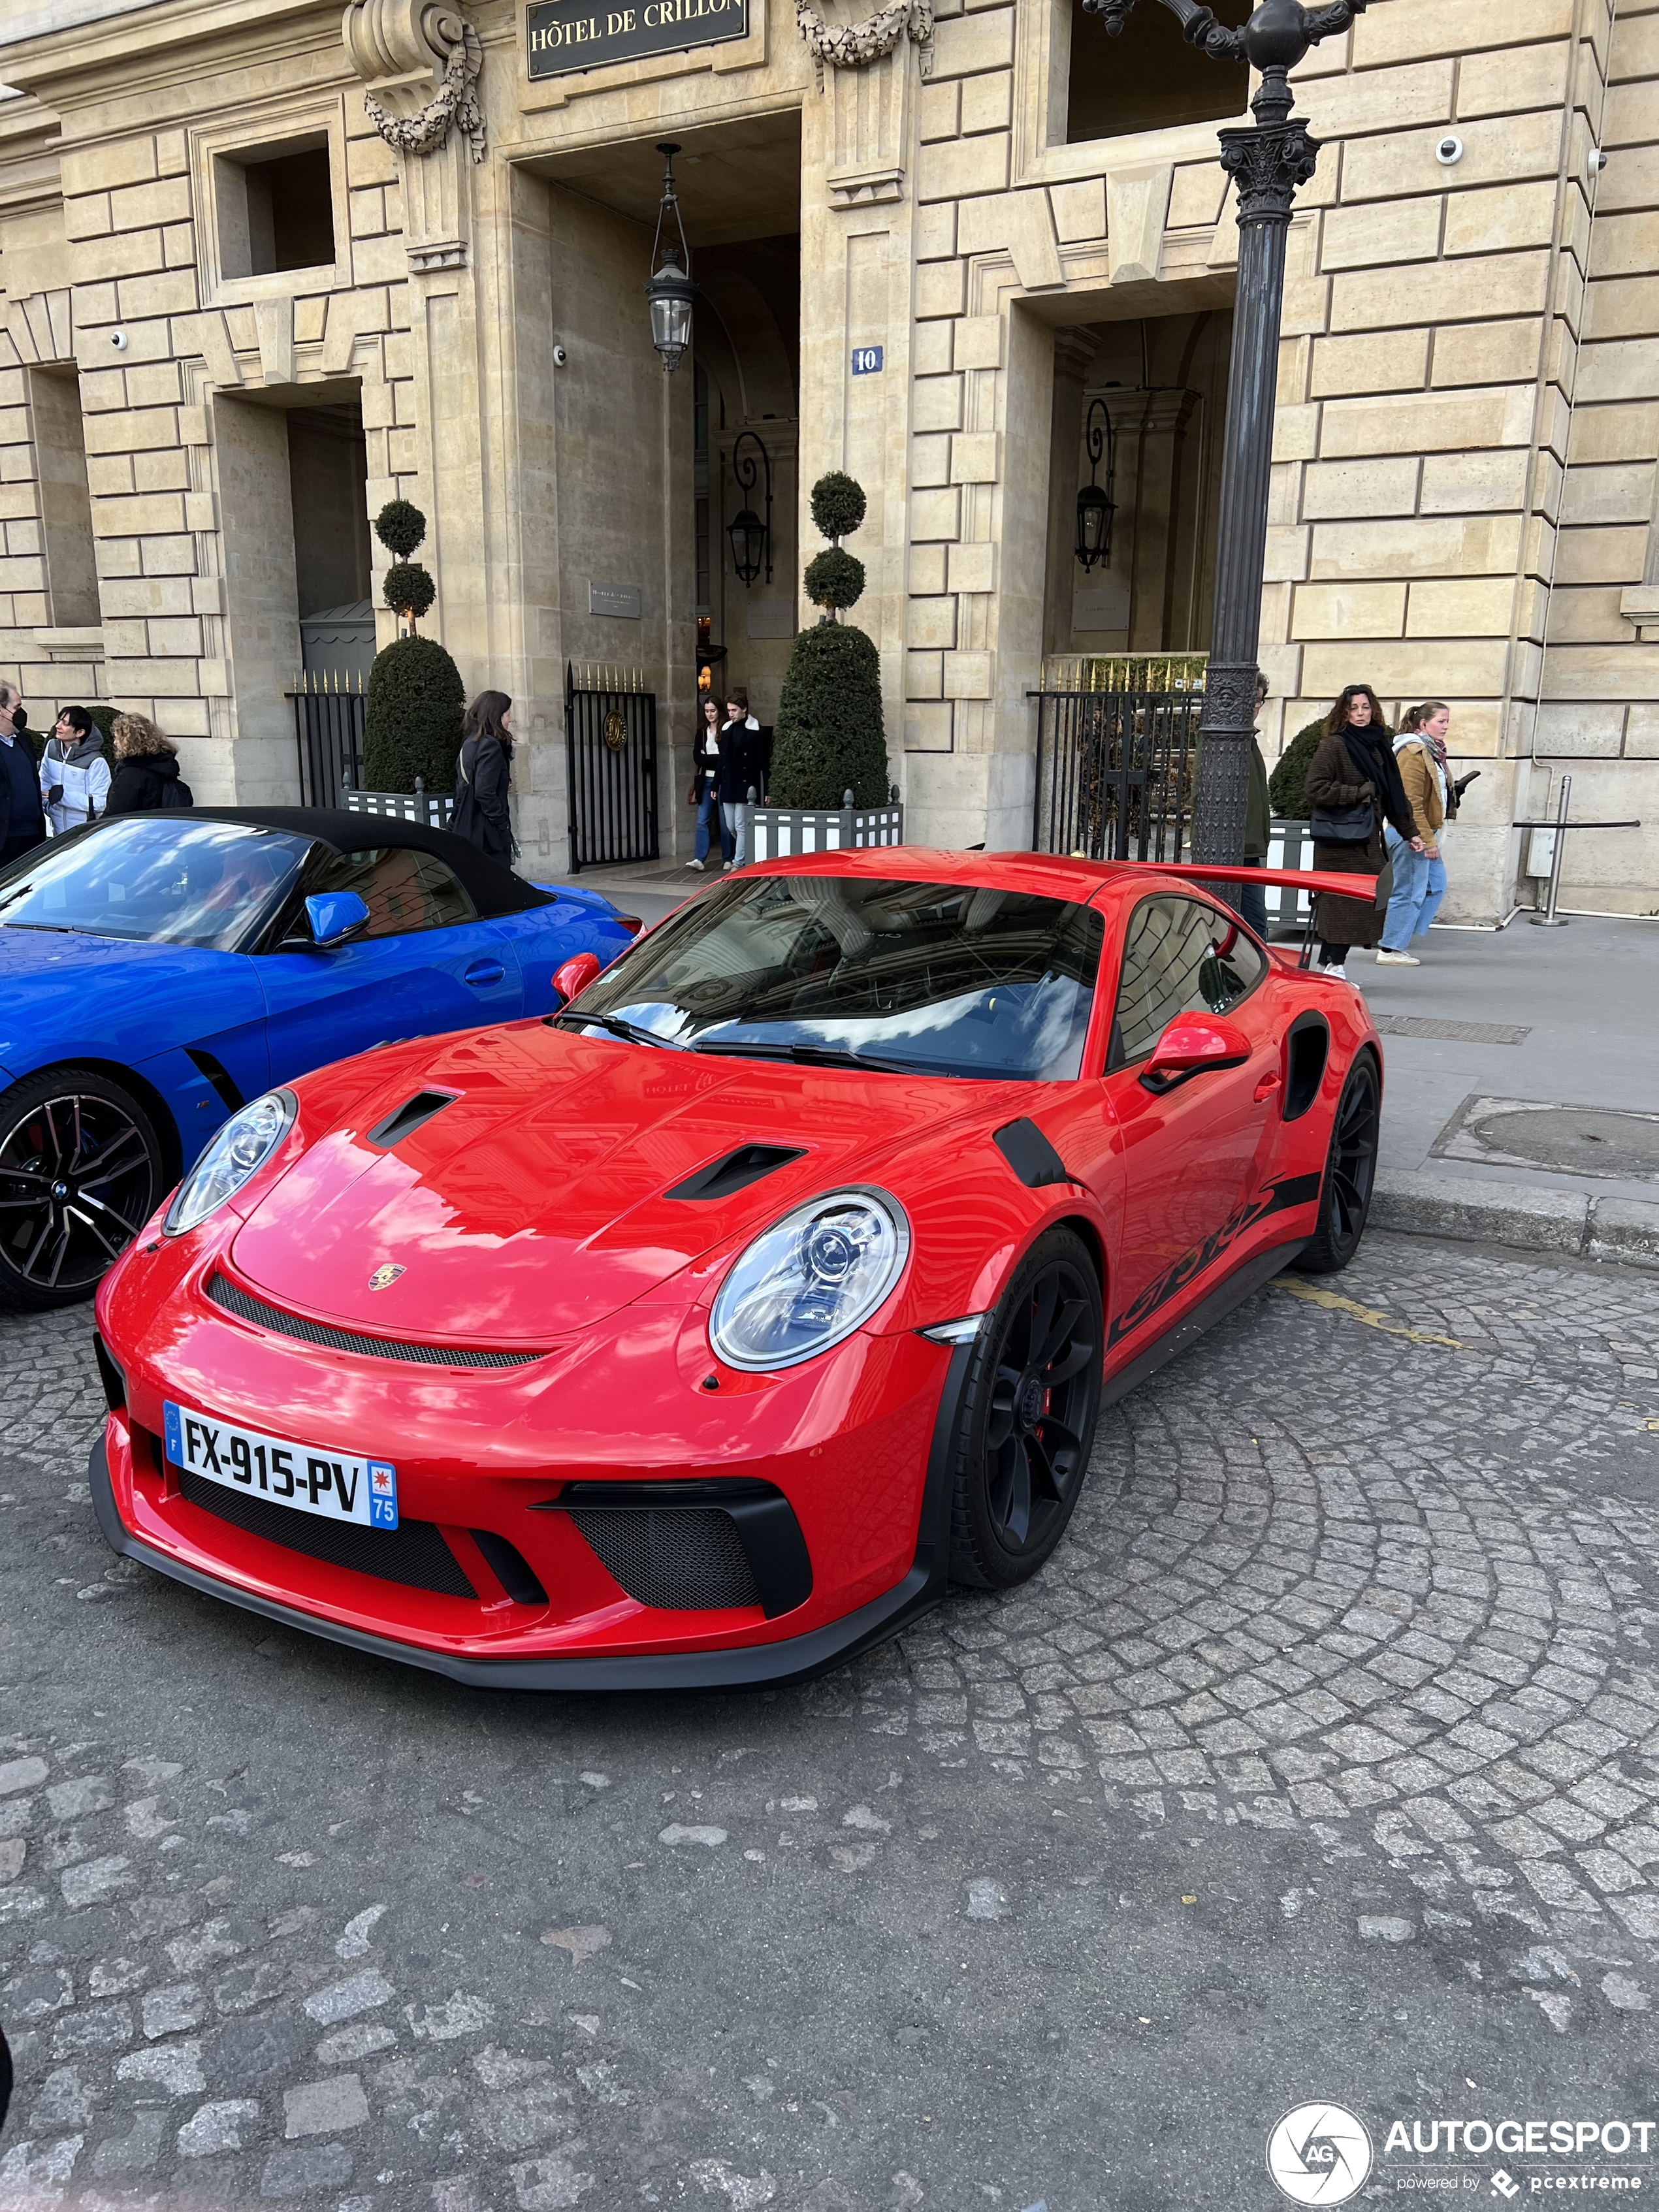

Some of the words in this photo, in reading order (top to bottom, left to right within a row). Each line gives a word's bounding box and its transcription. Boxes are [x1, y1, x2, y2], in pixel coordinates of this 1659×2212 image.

[531, 18, 602, 52] HÔTEL
[607, 8, 636, 35] DE
[858, 350, 876, 370] 10
[171, 1439, 176, 1451] F
[185, 1418, 359, 1513] FX-915-PV
[373, 1498, 394, 1521] 75
